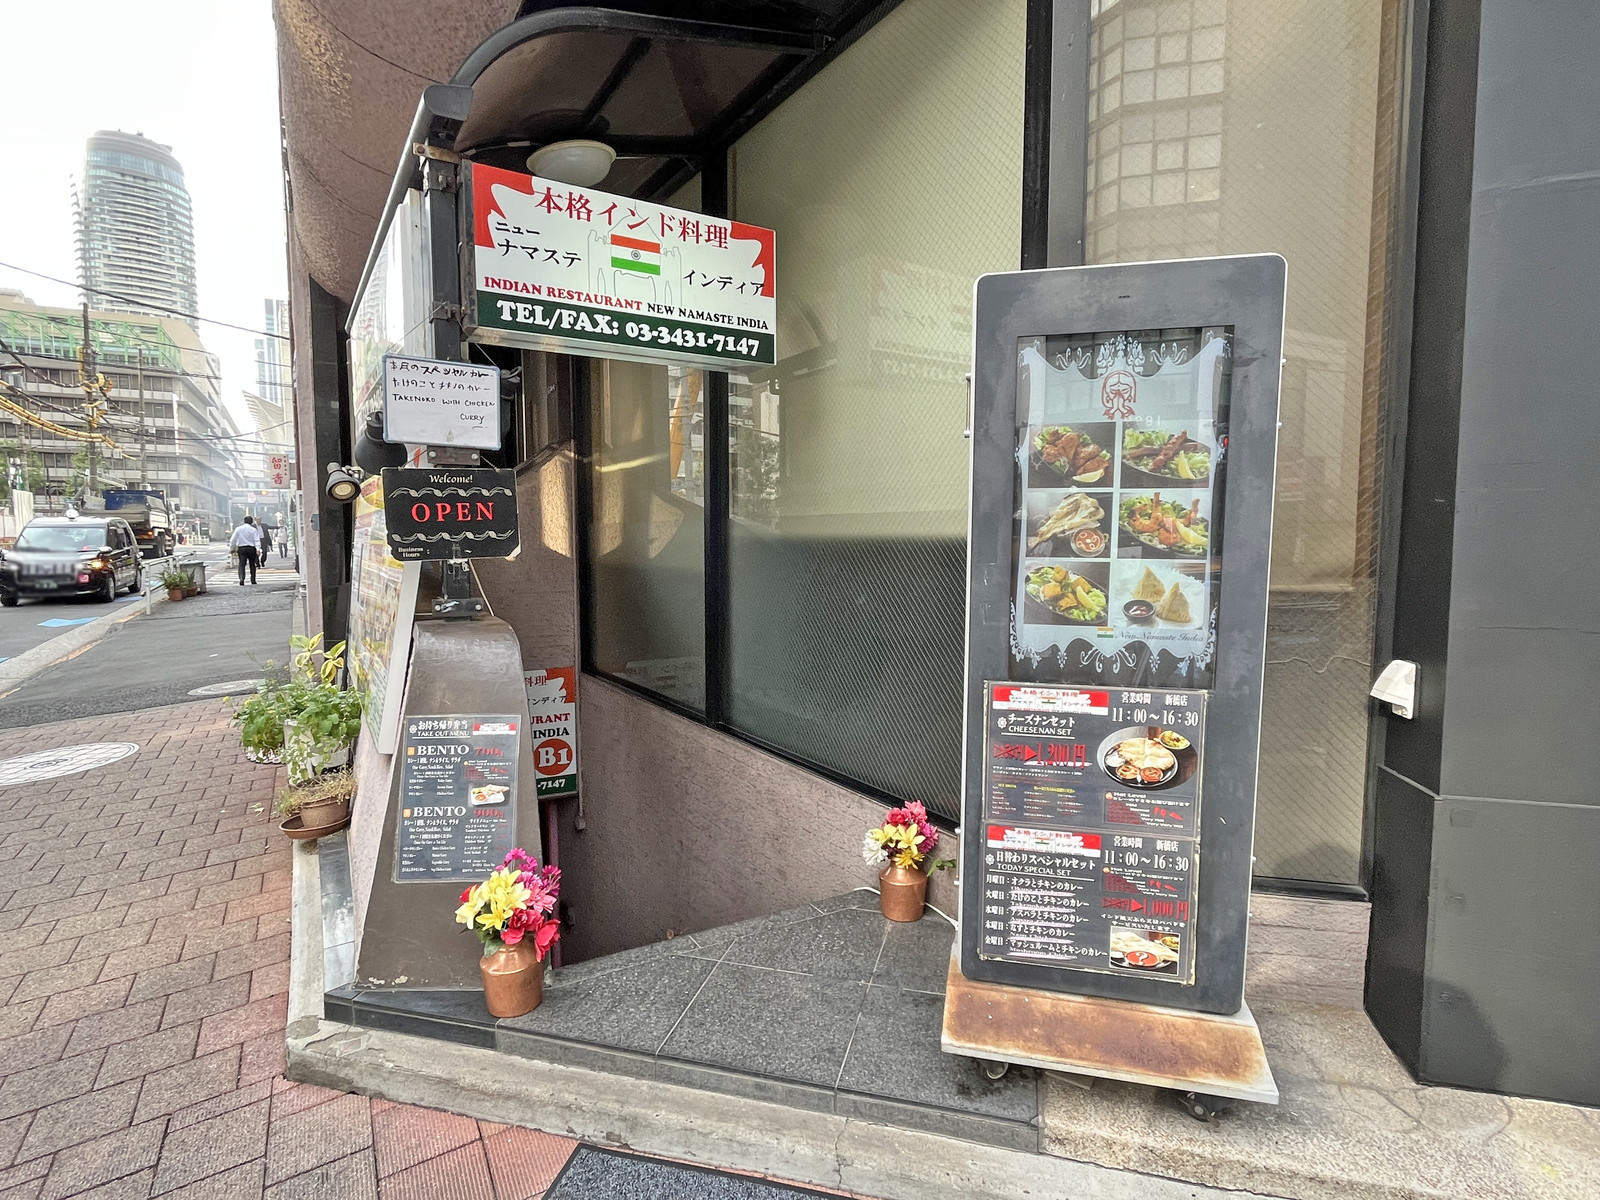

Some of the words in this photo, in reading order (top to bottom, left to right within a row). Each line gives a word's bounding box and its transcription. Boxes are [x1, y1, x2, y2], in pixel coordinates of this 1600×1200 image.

[535, 186, 729, 249] 本格インド料理
[495, 221, 540, 235] ニュー
[498, 239, 581, 268] ナマステ
[683, 269, 765, 296] インディア
[484, 276, 542, 295] INDIAN
[546, 286, 643, 311] RESTAURANT
[647, 302, 675, 315] NEW
[678, 307, 734, 325] NAMASTE
[737, 316, 769, 331] INDIA
[496, 300, 619, 336] TEL/FAX:
[626, 321, 760, 356] 03-3431-7147
[392, 393, 436, 403] TAKENOKO
[465, 399, 495, 407] CHICKEN
[429, 472, 473, 484] Welcome!
[411, 502, 494, 522] OPEN
[528, 696, 566, 706] ンディア
[1121, 692, 1151, 704] 営業時間
[1008, 713, 1075, 728] チーズナンセット
[533, 727, 569, 739] INDIA
[1057, 728, 1072, 736] SET
[417, 745, 469, 755] BENTO
[538, 747, 571, 767] B1
[413, 806, 466, 817] BENTO
[996, 851, 1096, 870] 日替わりスペシャルセット
[997, 863, 1022, 871] TODAY
[1024, 865, 1054, 875] SPECIAL
